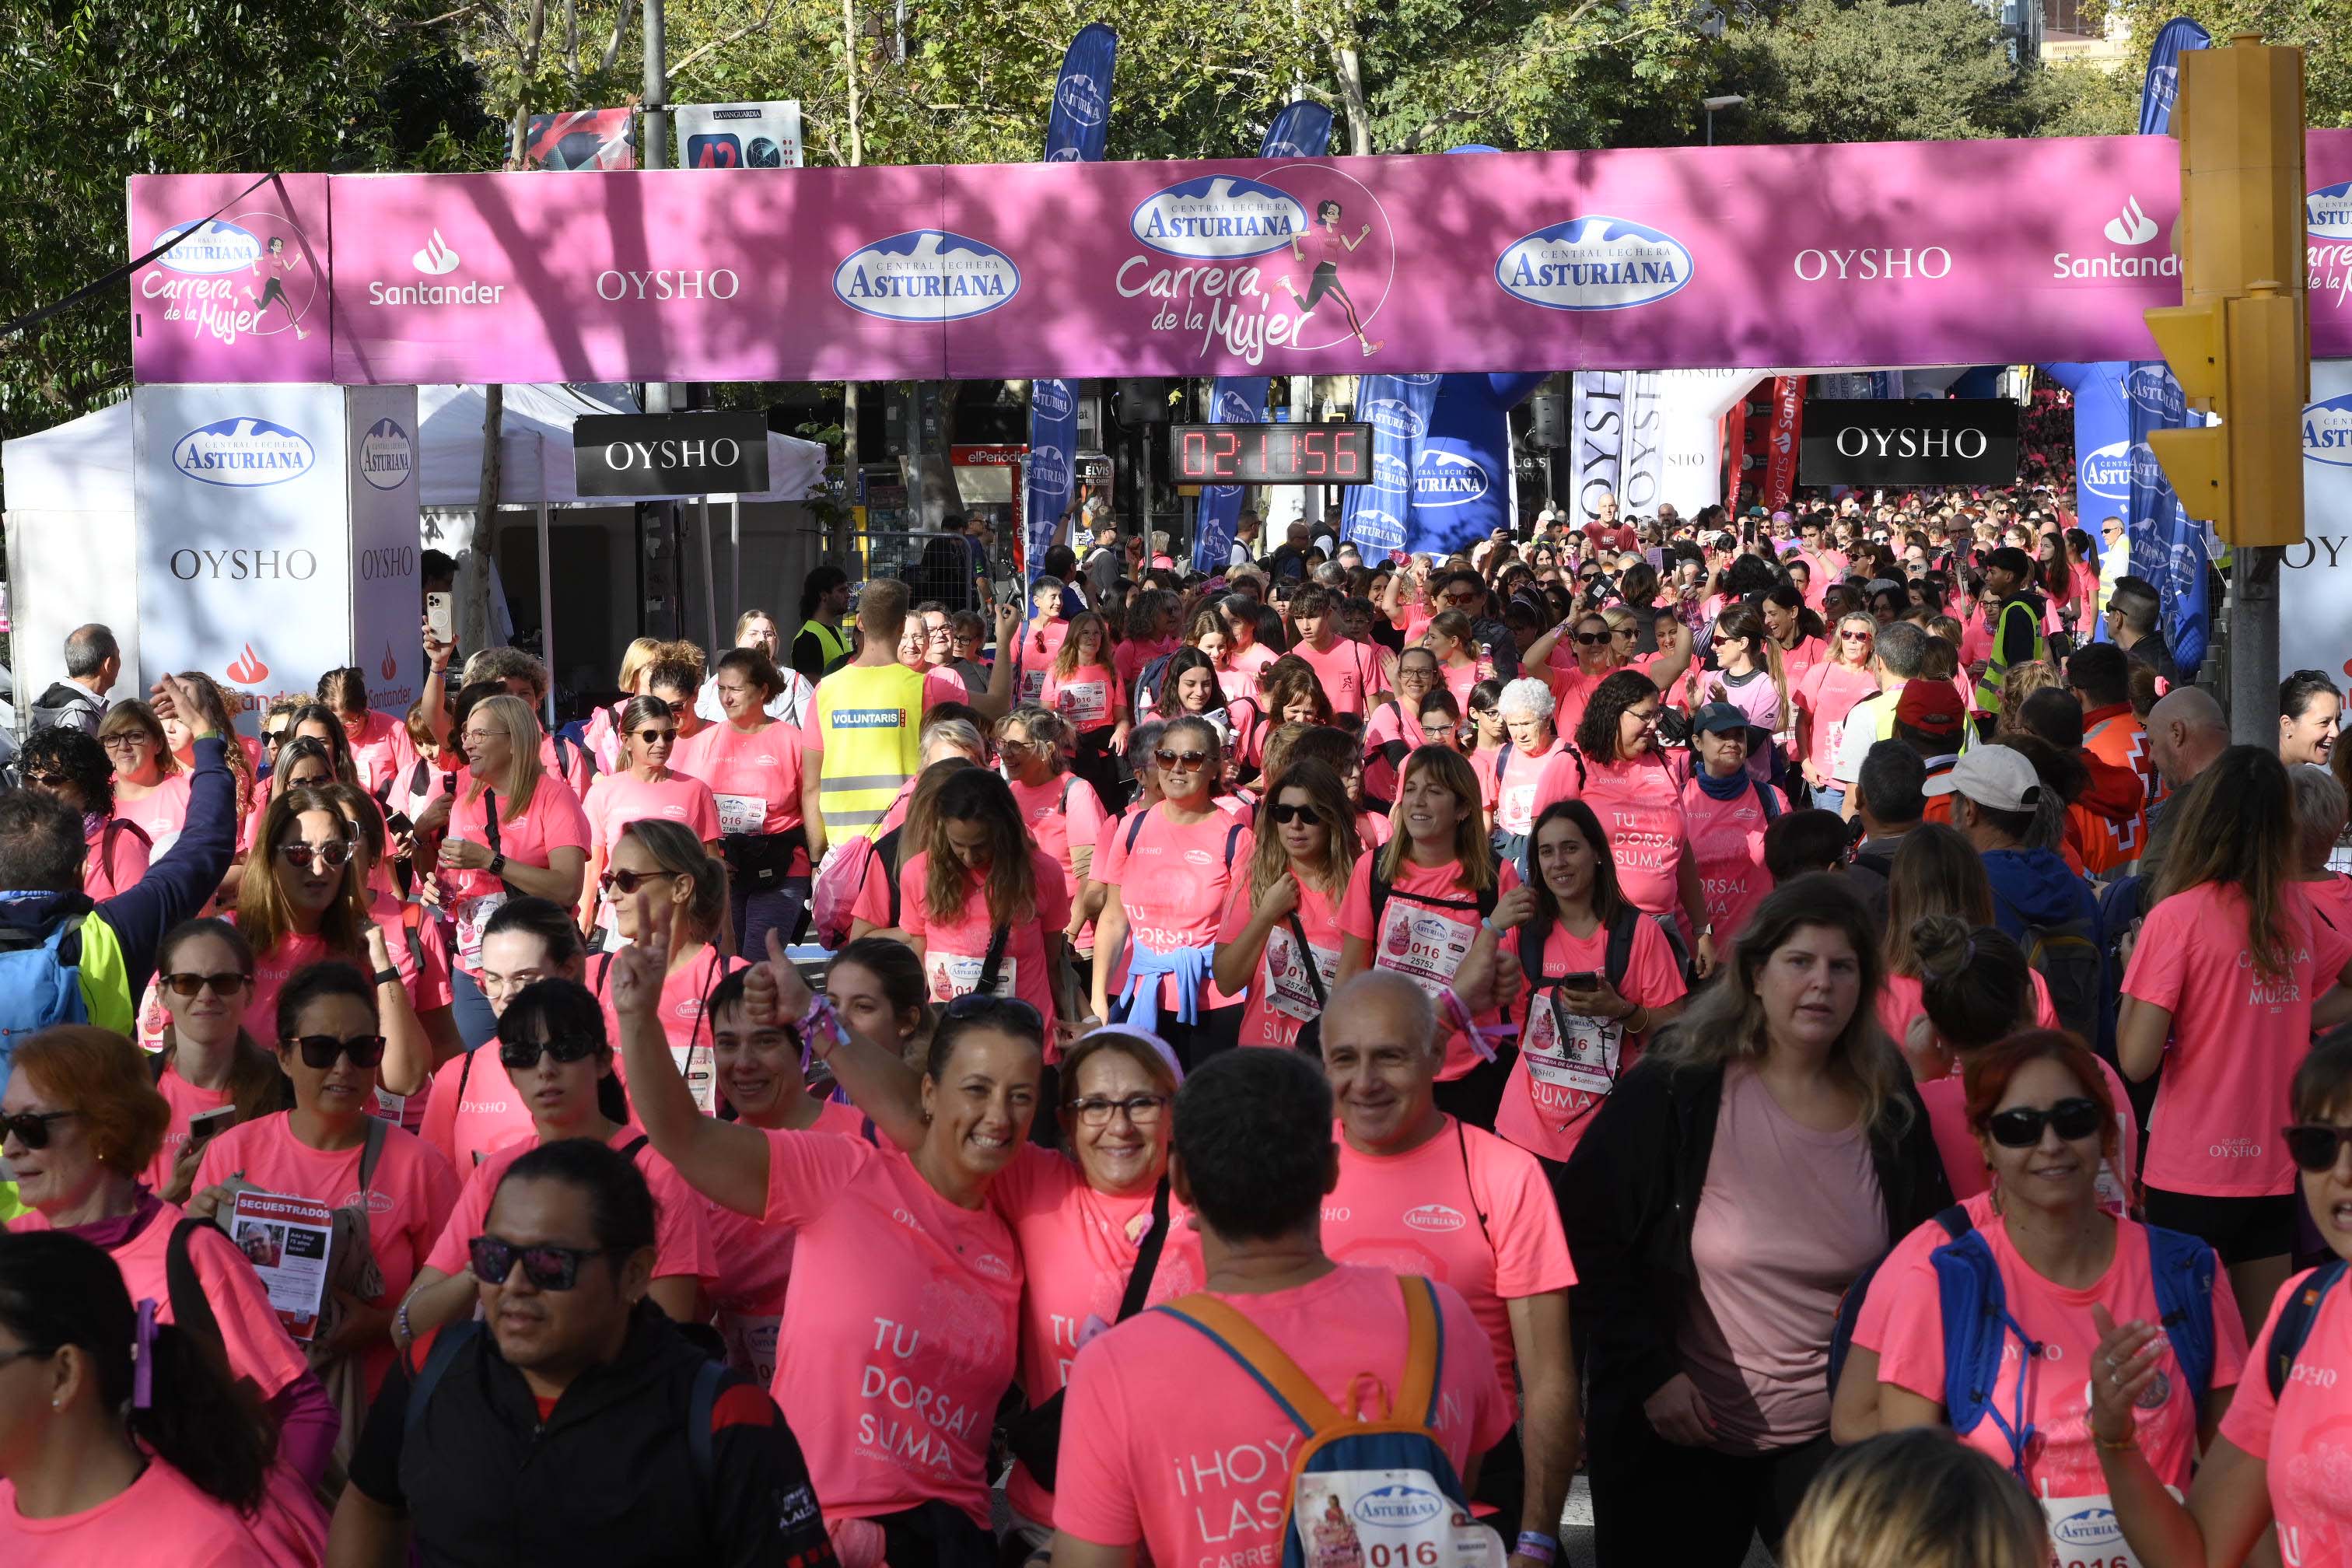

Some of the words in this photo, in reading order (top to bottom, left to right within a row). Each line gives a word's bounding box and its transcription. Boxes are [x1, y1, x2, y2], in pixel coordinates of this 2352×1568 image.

[1171, 204, 1227, 213] CENTRAL
[1233, 203, 1289, 212] LECHERA
[1144, 207, 1294, 239] ASTURIANA
[159, 240, 253, 260] ASTURIANA
[1541, 250, 1601, 259] CENTRAL
[1608, 247, 1671, 257] LECHERA
[877, 261, 935, 270] CENTRAL
[942, 261, 999, 269] LECHERA
[1510, 253, 1678, 287] ASTURIANA
[1794, 247, 1952, 281] OYSHO
[2053, 252, 2183, 279] Santand
[142, 271, 233, 299] Carrera
[596, 268, 740, 302] OYSHO
[847, 264, 1006, 298] ASTURIANA
[1115, 254, 1261, 298] Carrera
[2326, 268, 2340, 290] la
[369, 280, 504, 306] Santander
[164, 301, 181, 321] de
[184, 300, 198, 321] la
[194, 298, 268, 345] Mujer
[1151, 301, 1178, 331] de
[1185, 301, 1204, 331] la
[1199, 292, 1315, 366] Mujer
[254, 440, 300, 449] LECHERA
[1836, 426, 1987, 459] OYSHO
[184, 443, 305, 470] ASTURIANA
[363, 445, 409, 473] ASTURIANA
[605, 437, 740, 471] OYSHO
[1668, 453, 1705, 467] SHO
[1085, 465, 1110, 476] ELVIS
[170, 548, 317, 581] OYSHO
[361, 546, 413, 580] OYSHO
[832, 713, 898, 724] VOLUNTARIS
[721, 816, 741, 825] 016
[1612, 812, 1636, 827] TU
[1136, 846, 1162, 855] OYSHO
[1615, 850, 1665, 870] SUMA
[1122, 903, 1146, 921] TU
[1411, 942, 1440, 960] 016
[1410, 957, 1434, 970] 25752
[1285, 979, 1308, 994] 25749
[2249, 985, 2301, 1006] MUJER
[1262, 1021, 1300, 1045] SUM
[1531, 1055, 1557, 1066] CARRERA
[1573, 1062, 1593, 1074] MUJER
[1577, 1076, 1607, 1088] Santander
[1531, 1080, 1593, 1109] SUMA
[460, 1101, 506, 1113] OYSHO
[2209, 1143, 2262, 1158] OYSHO
[240, 1199, 331, 1220] SECUESTRADOS
[1409, 1212, 1461, 1227] ASTURIANA
[873, 1316, 920, 1359] TU
[858, 1412, 954, 1471] SUMA
[1196, 1489, 1285, 1544] LAS
[1363, 1502, 1436, 1520] ASTURIANA
[2060, 1524, 2123, 1539] ASTURIAN
[1370, 1542, 1438, 1568] 016
